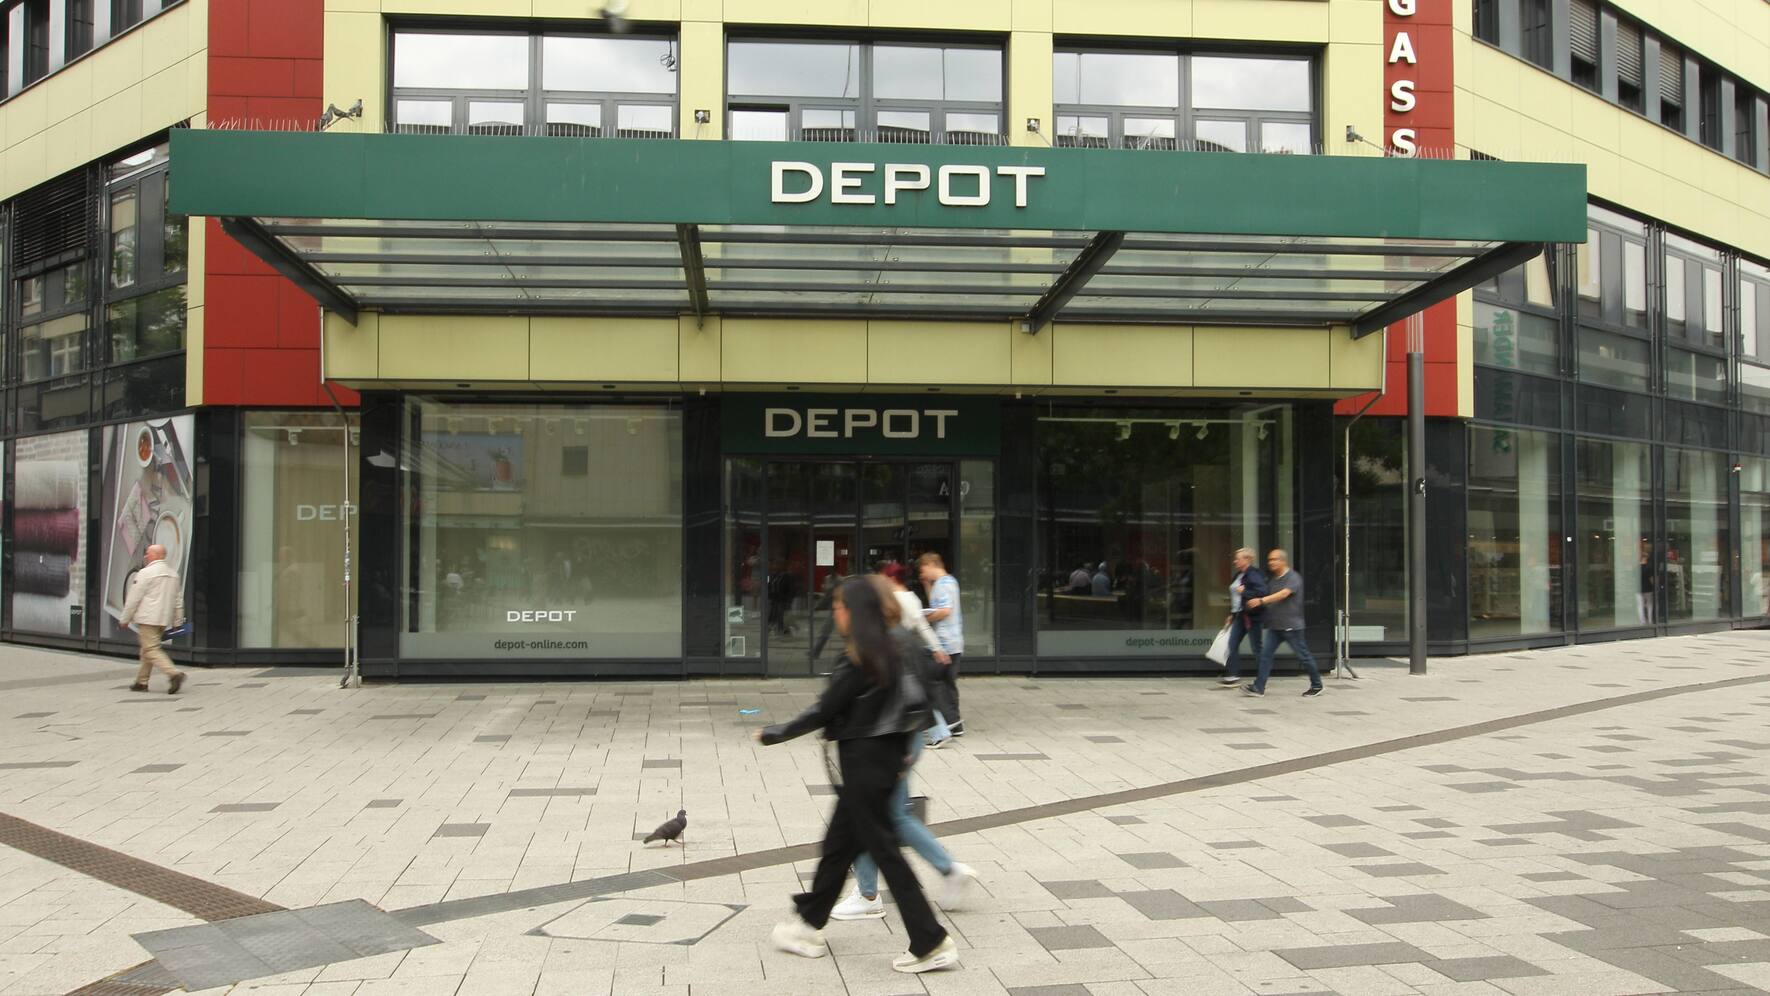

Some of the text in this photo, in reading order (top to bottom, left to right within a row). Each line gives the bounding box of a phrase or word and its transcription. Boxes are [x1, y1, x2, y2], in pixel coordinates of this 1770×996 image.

[771, 161, 1046, 208] DEPOT
[765, 408, 958, 439] DEPOT
[507, 610, 577, 622] DEPOT
[494, 639, 588, 651] depot-online.com
[1126, 636, 1213, 648] depot-online.com
